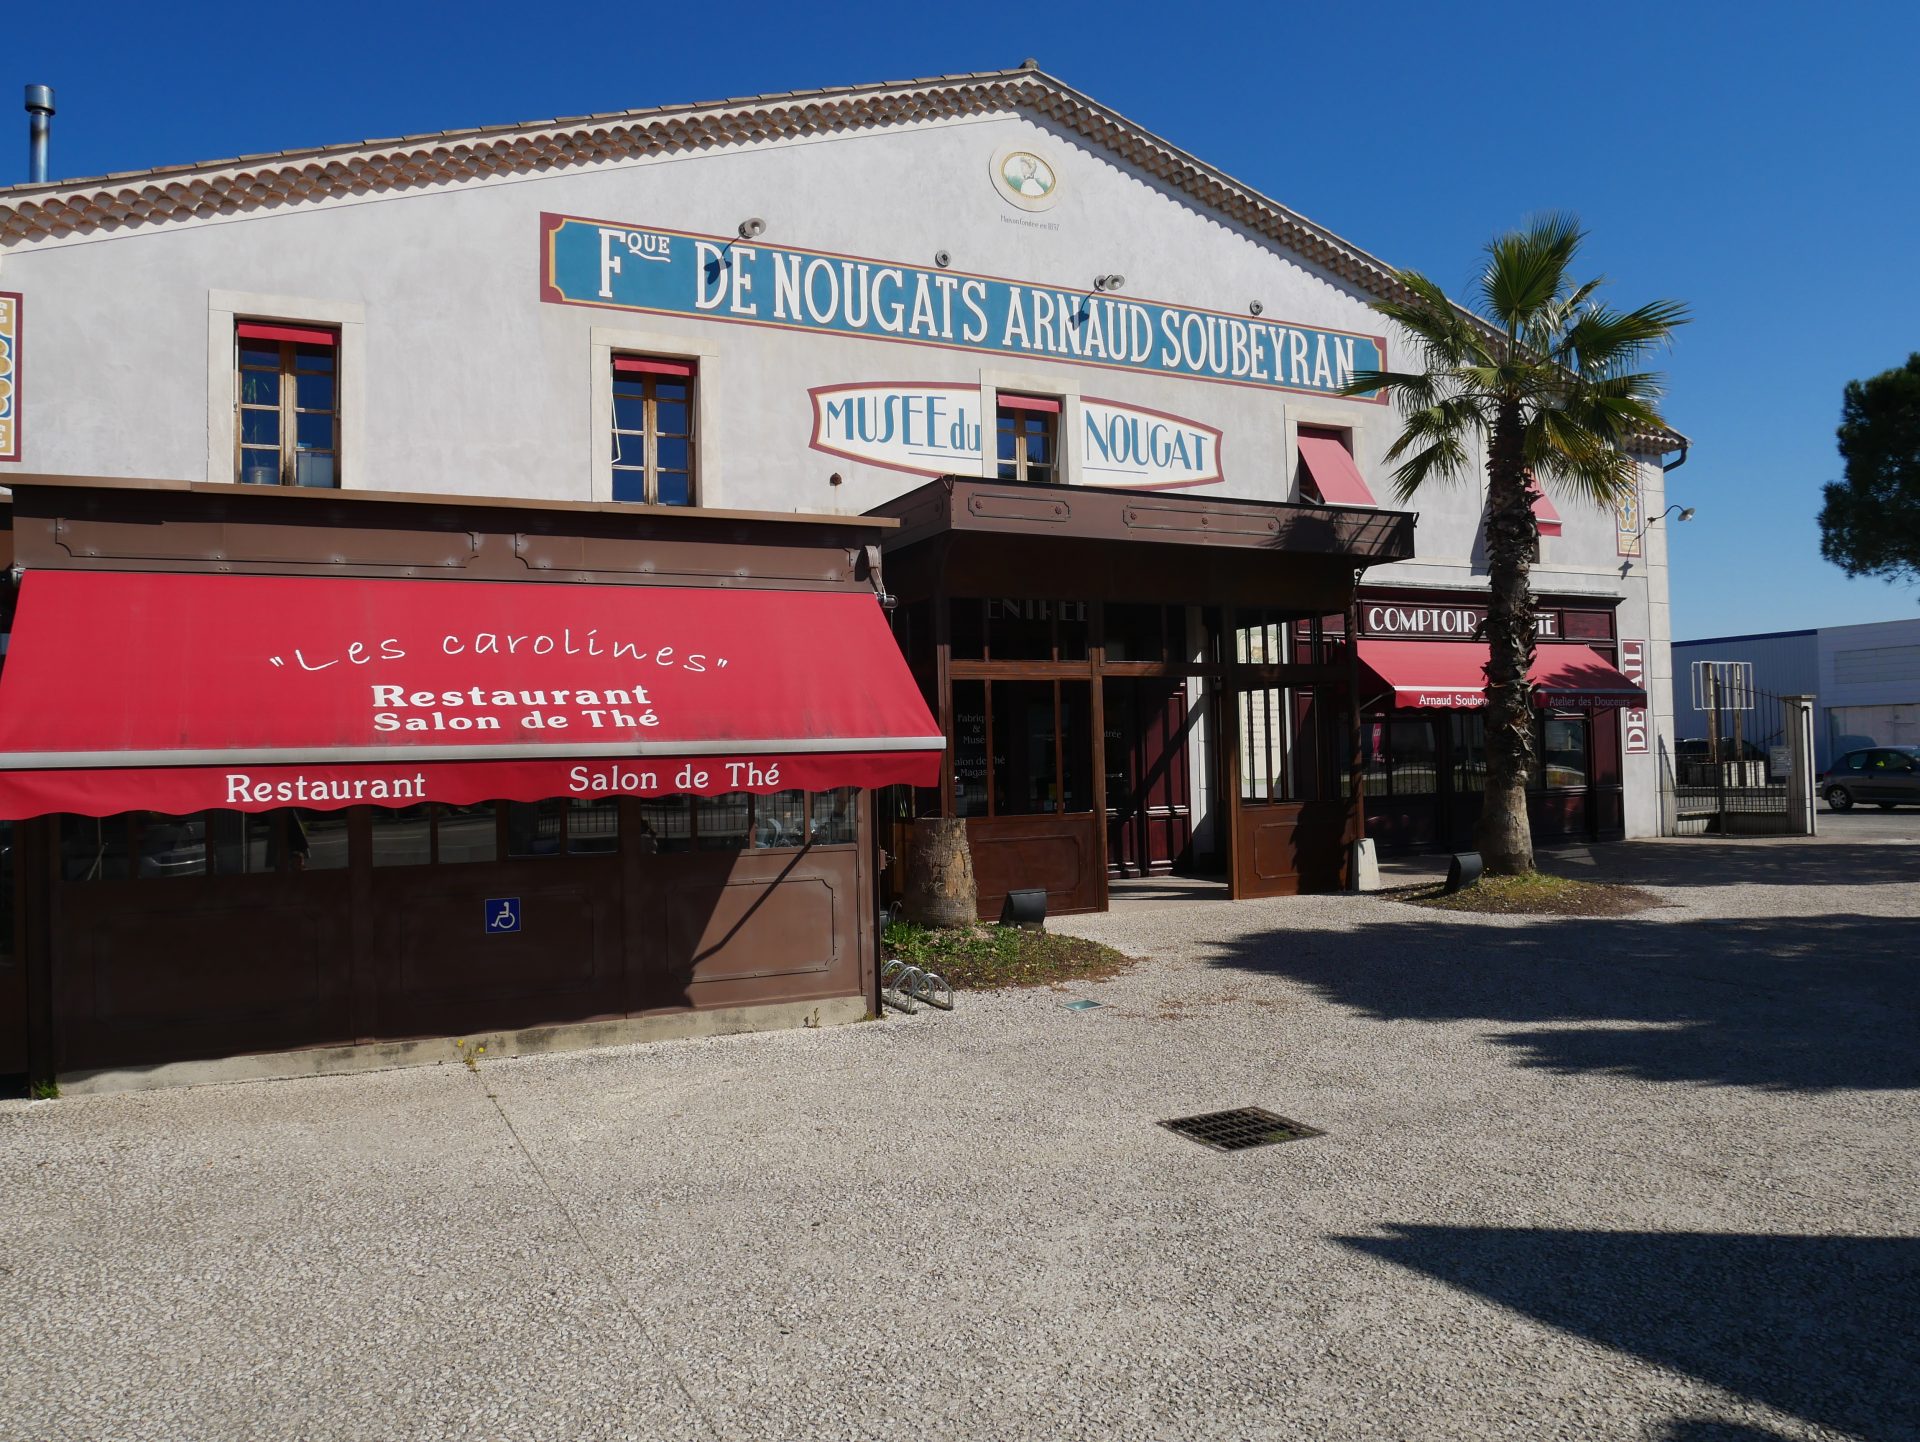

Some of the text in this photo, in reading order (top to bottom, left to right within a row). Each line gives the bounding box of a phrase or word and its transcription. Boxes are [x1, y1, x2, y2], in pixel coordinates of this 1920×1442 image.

[695, 241, 757, 316] DE
[772, 252, 989, 343] NOUGATS
[1002, 286, 1154, 364] ARNAUD
[1161, 309, 1355, 391] SOUBEYRAN
[827, 395, 1208, 472] MUSEE du NOUGAT
[1369, 607, 1477, 633] COMPTOIR
[371, 685, 652, 707] Restaurant
[1418, 694, 1452, 705] Arnaud
[1549, 696, 1630, 706] Atelier des Douceurs
[373, 709, 660, 732] Salon de Thé
[226, 773, 426, 803] Restaurant
[569, 763, 780, 792] Salon de Thé
